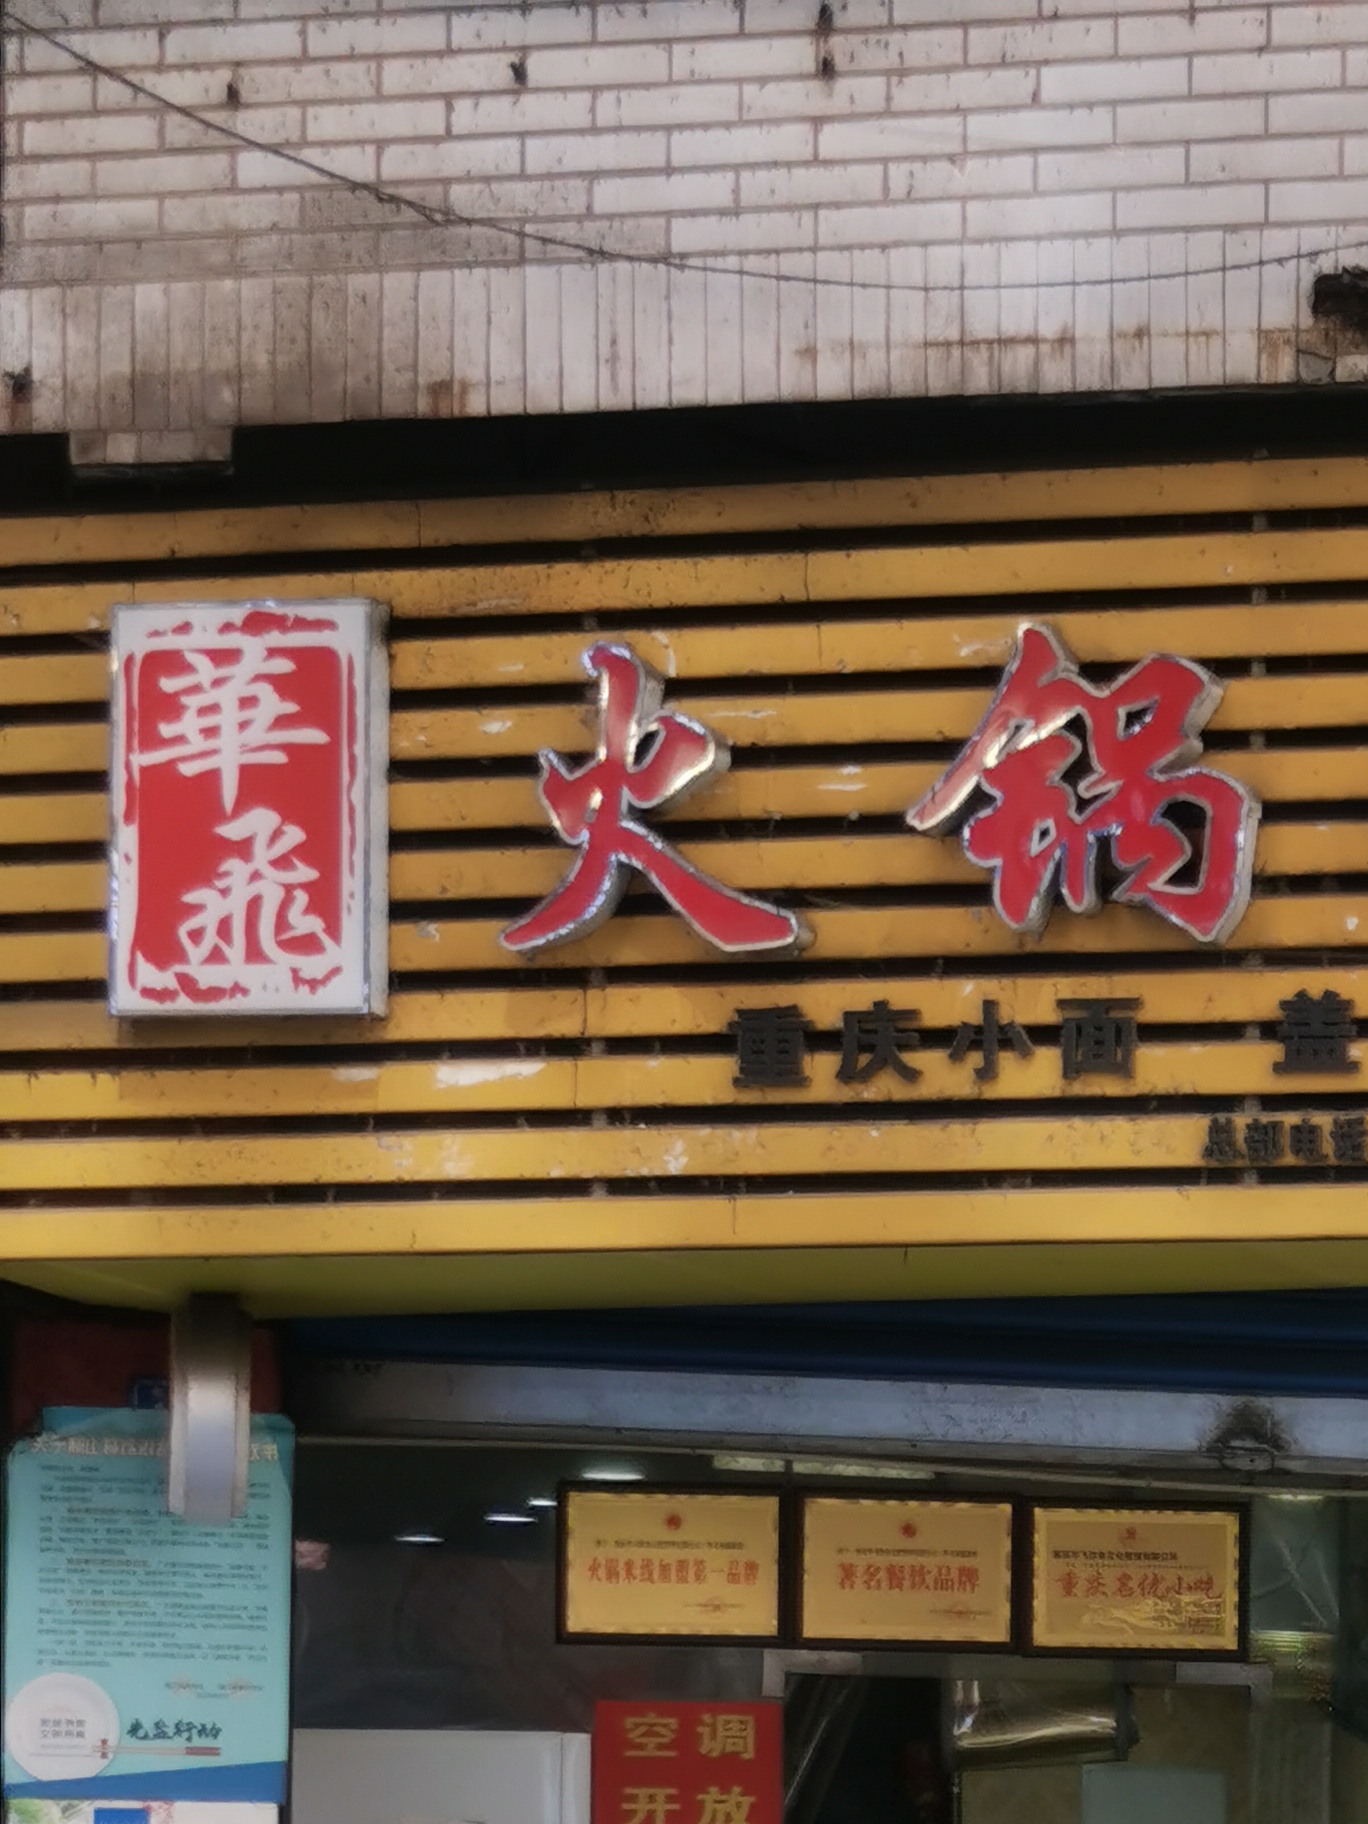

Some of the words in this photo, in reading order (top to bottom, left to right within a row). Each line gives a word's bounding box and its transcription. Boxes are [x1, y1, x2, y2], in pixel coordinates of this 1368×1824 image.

[728, 997, 1143, 1088] 重庆小面
[623, 1713, 755, 1760] 空调
